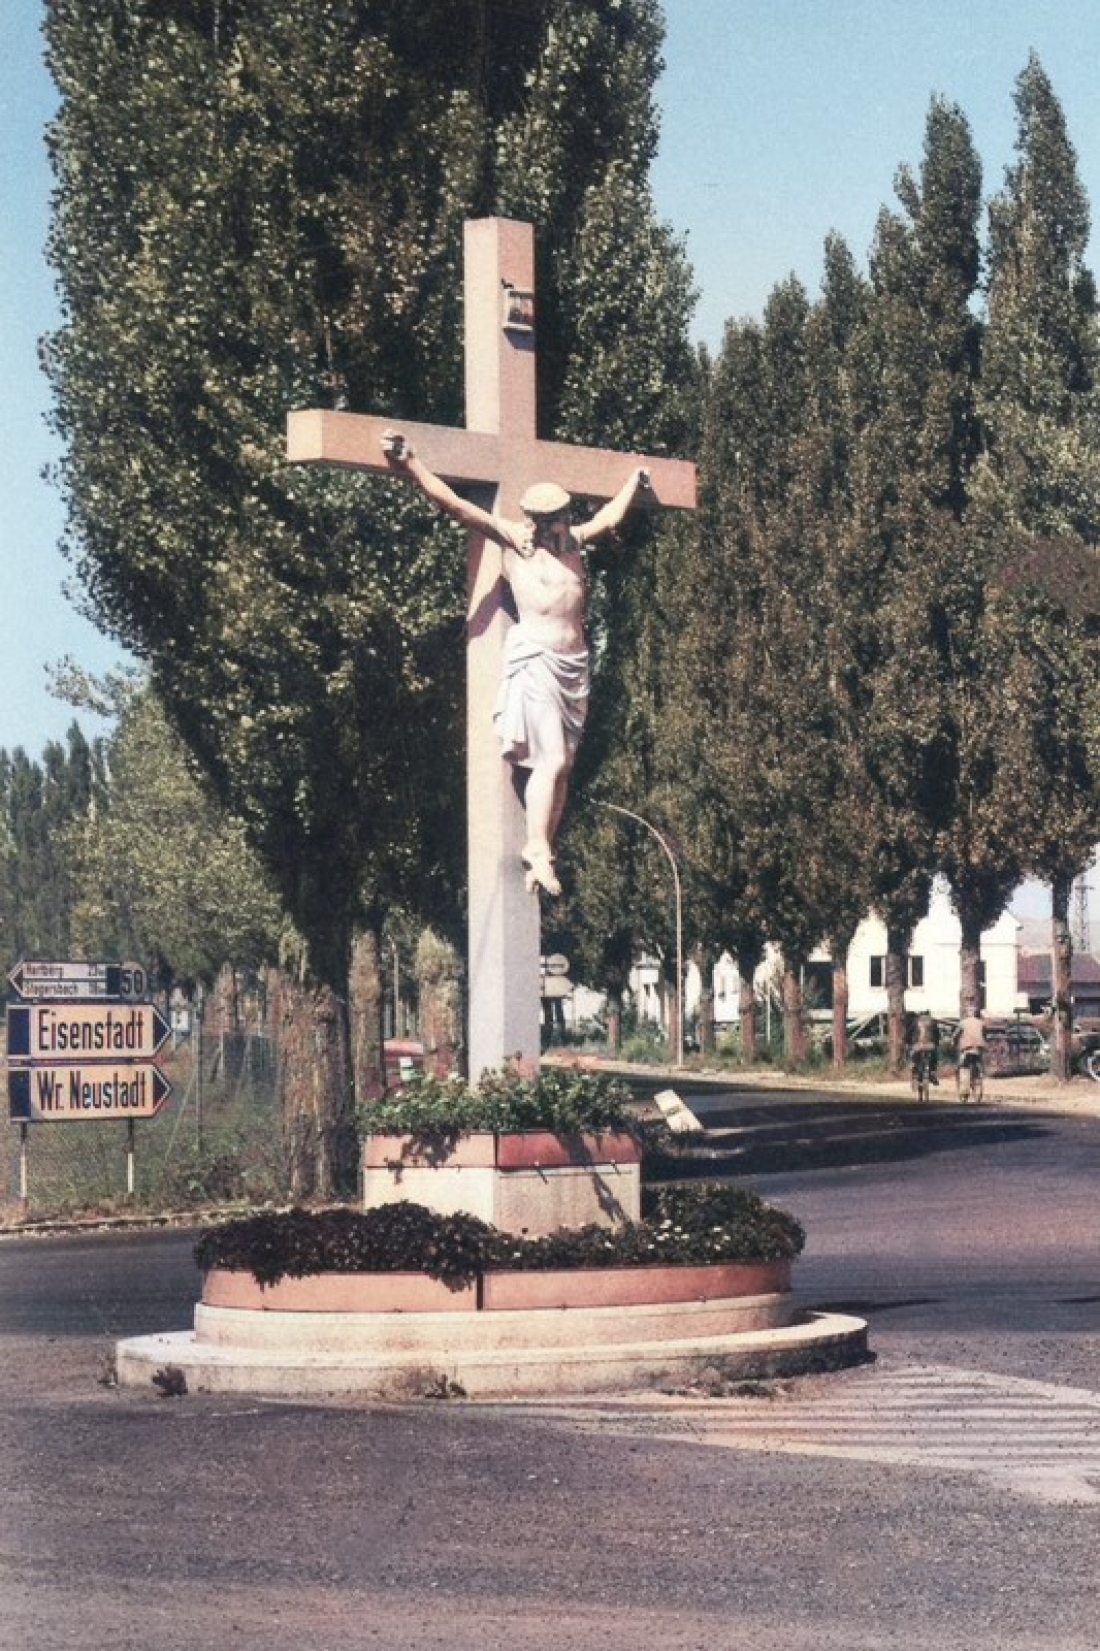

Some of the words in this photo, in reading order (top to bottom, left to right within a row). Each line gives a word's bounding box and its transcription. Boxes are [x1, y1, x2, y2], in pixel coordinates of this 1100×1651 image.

[122, 970, 143, 995] 50
[38, 1009, 144, 1050] Eisenstadt
[70, 1071, 146, 1110] Neustadt
